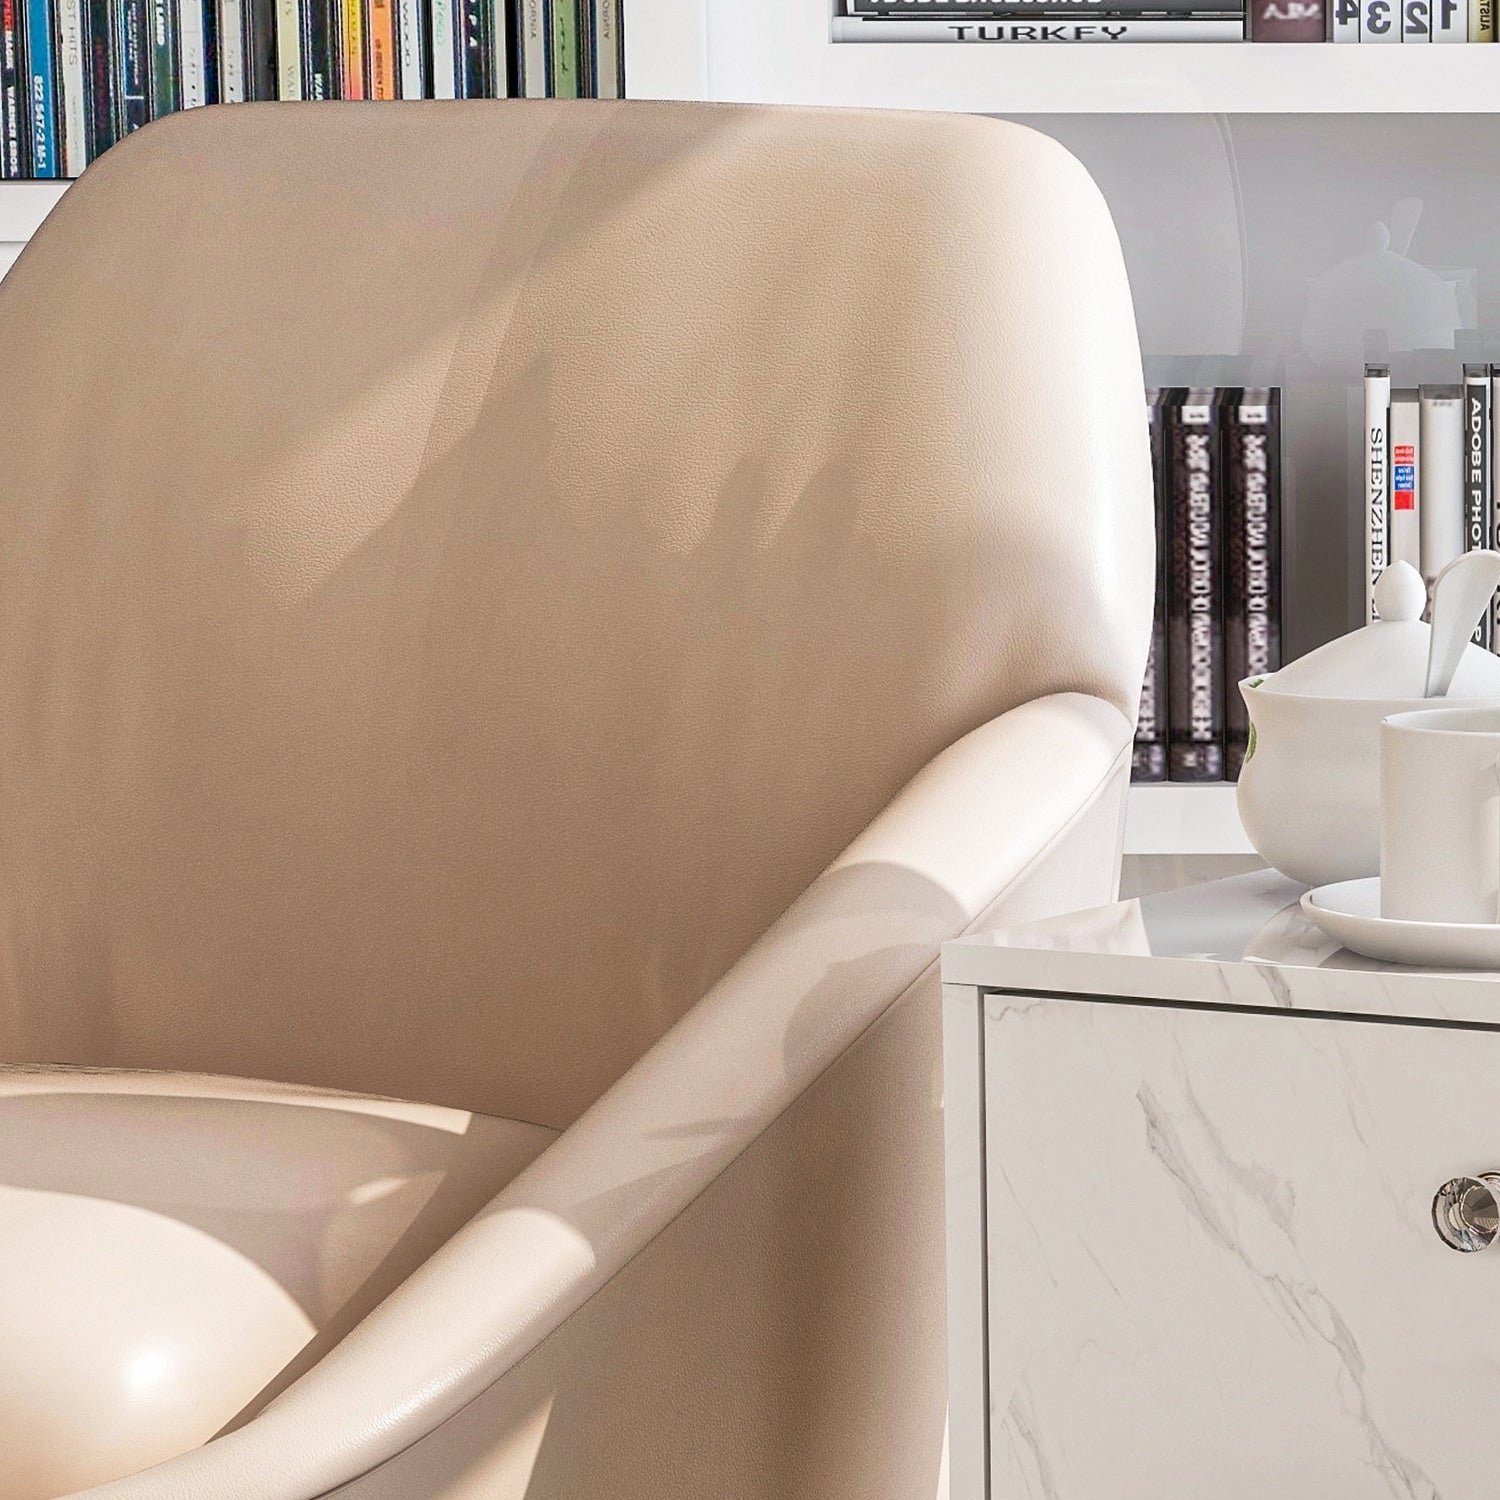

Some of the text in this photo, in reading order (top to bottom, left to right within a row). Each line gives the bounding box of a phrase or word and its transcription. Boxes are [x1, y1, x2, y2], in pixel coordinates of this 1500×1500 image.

[34, 75, 44, 101] 822
[7, 85, 17, 138] WARNER
[35, 102, 46, 141] 547-2
[1471, 398, 1482, 484] ADOBE
